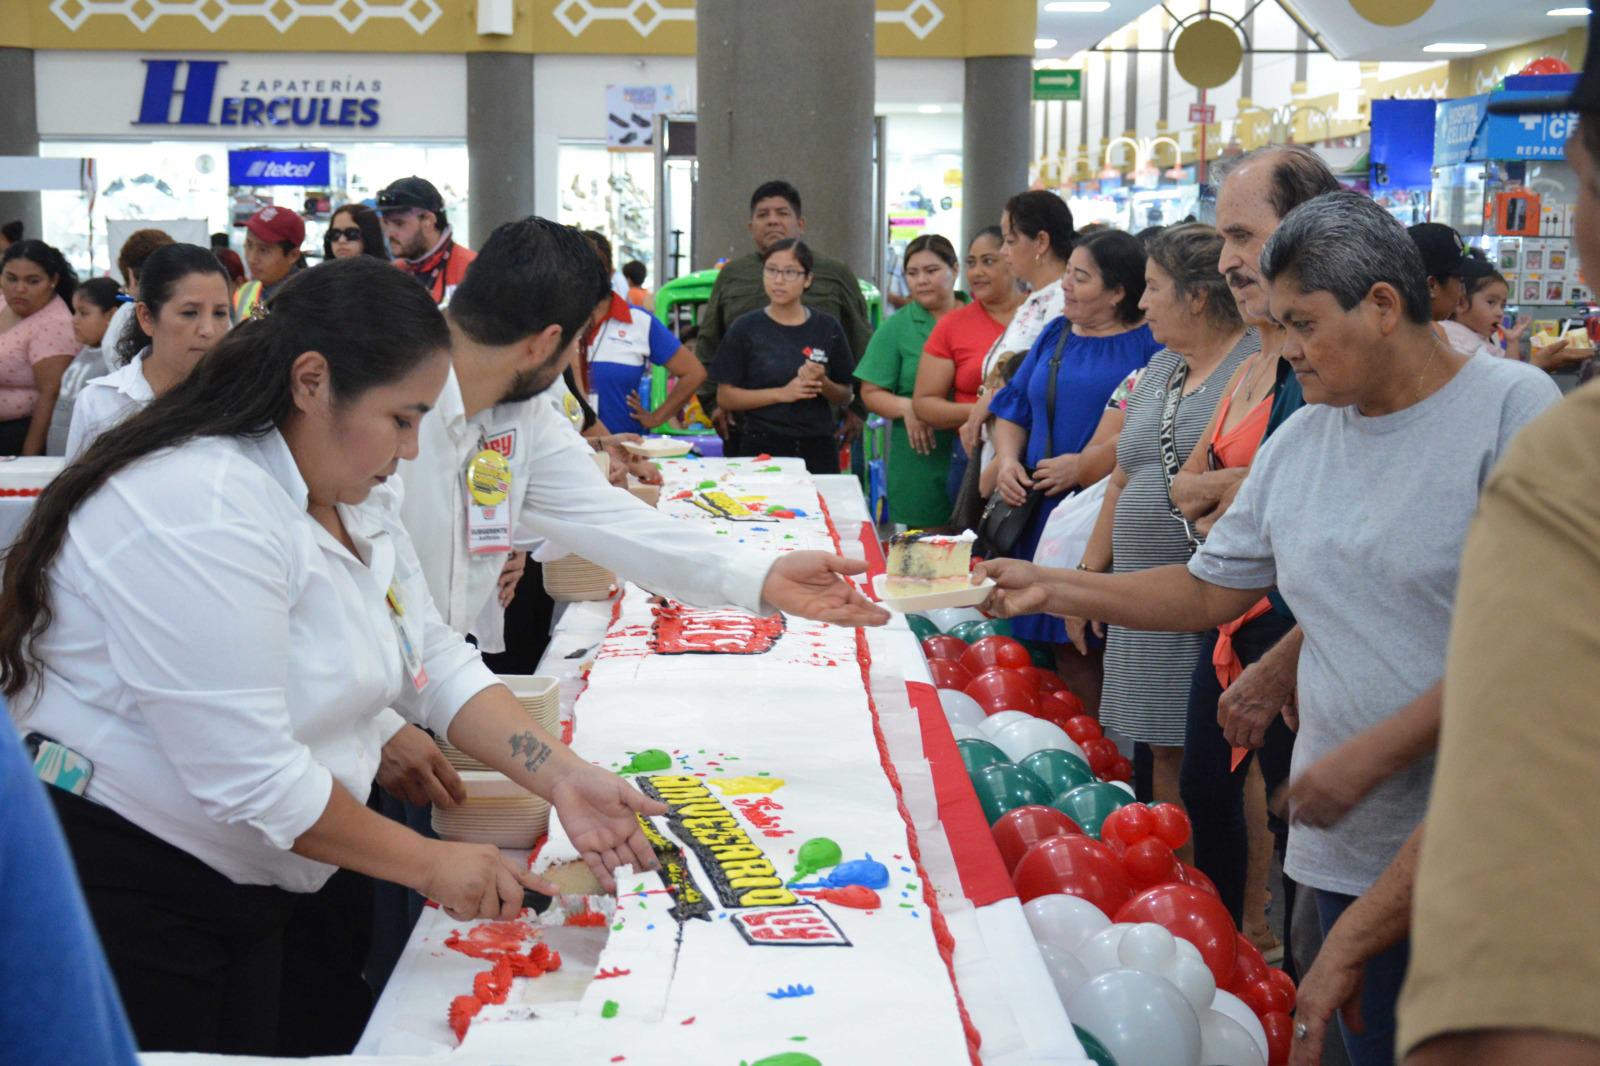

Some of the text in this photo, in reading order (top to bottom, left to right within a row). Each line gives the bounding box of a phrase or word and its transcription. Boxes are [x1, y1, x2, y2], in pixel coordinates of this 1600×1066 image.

[240, 75, 382, 92] ZAPATERÍAS
[131, 59, 380, 127] HERCULES
[1516, 146, 1564, 156] REPARA
[264, 161, 315, 177] telcel
